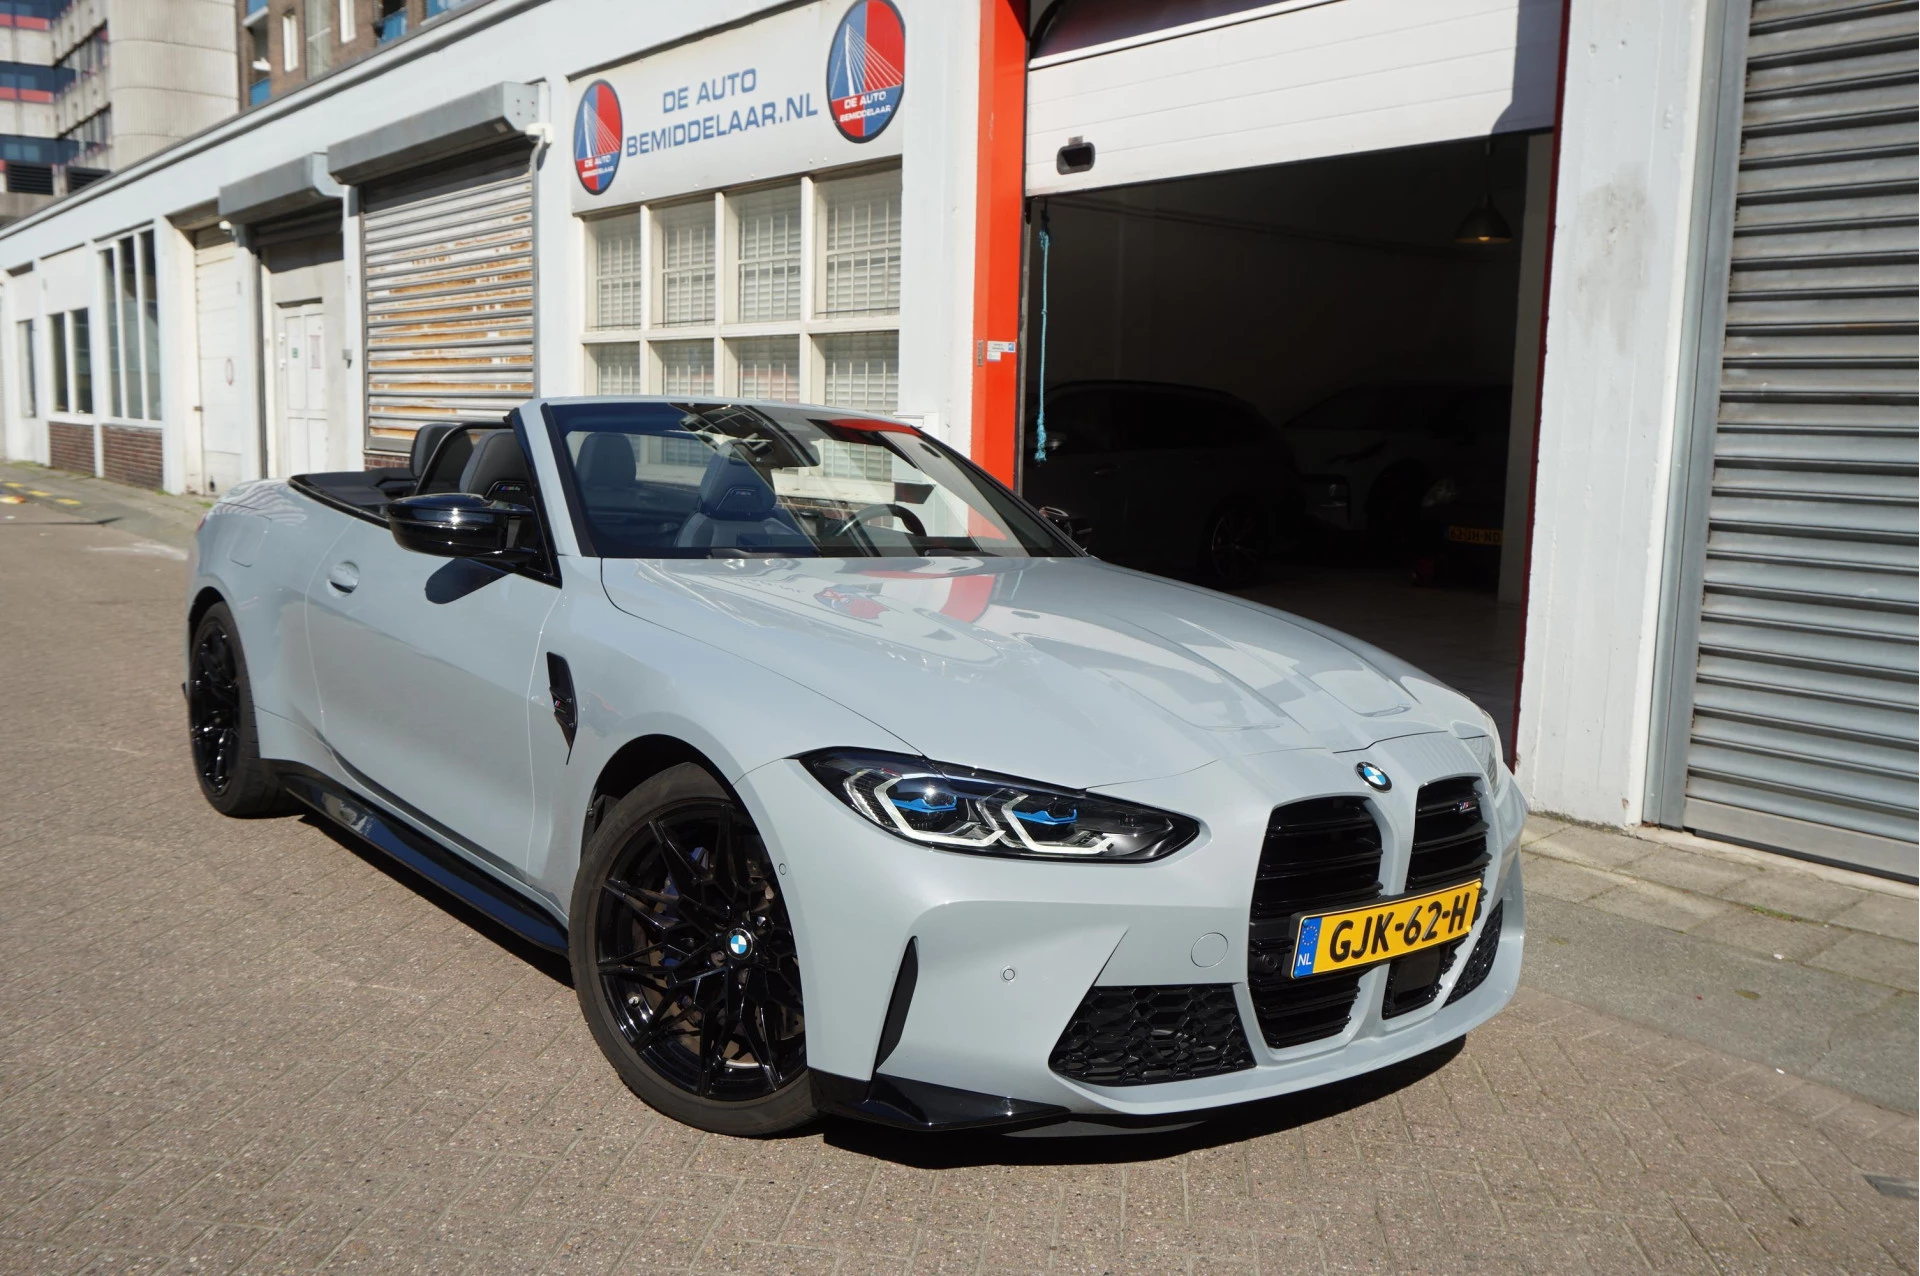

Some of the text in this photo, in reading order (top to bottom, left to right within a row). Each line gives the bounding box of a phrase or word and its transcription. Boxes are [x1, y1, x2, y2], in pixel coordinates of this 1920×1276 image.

[662, 67, 758, 114] DE AUTO
[843, 91, 887, 110] DE AUTO
[626, 93, 818, 157] BEMIDDELAAR.NL
[839, 104, 892, 122] BEMIDDELAAR
[1329, 891, 1471, 963] GJK-62-H
[1297, 953, 1312, 967] NL
